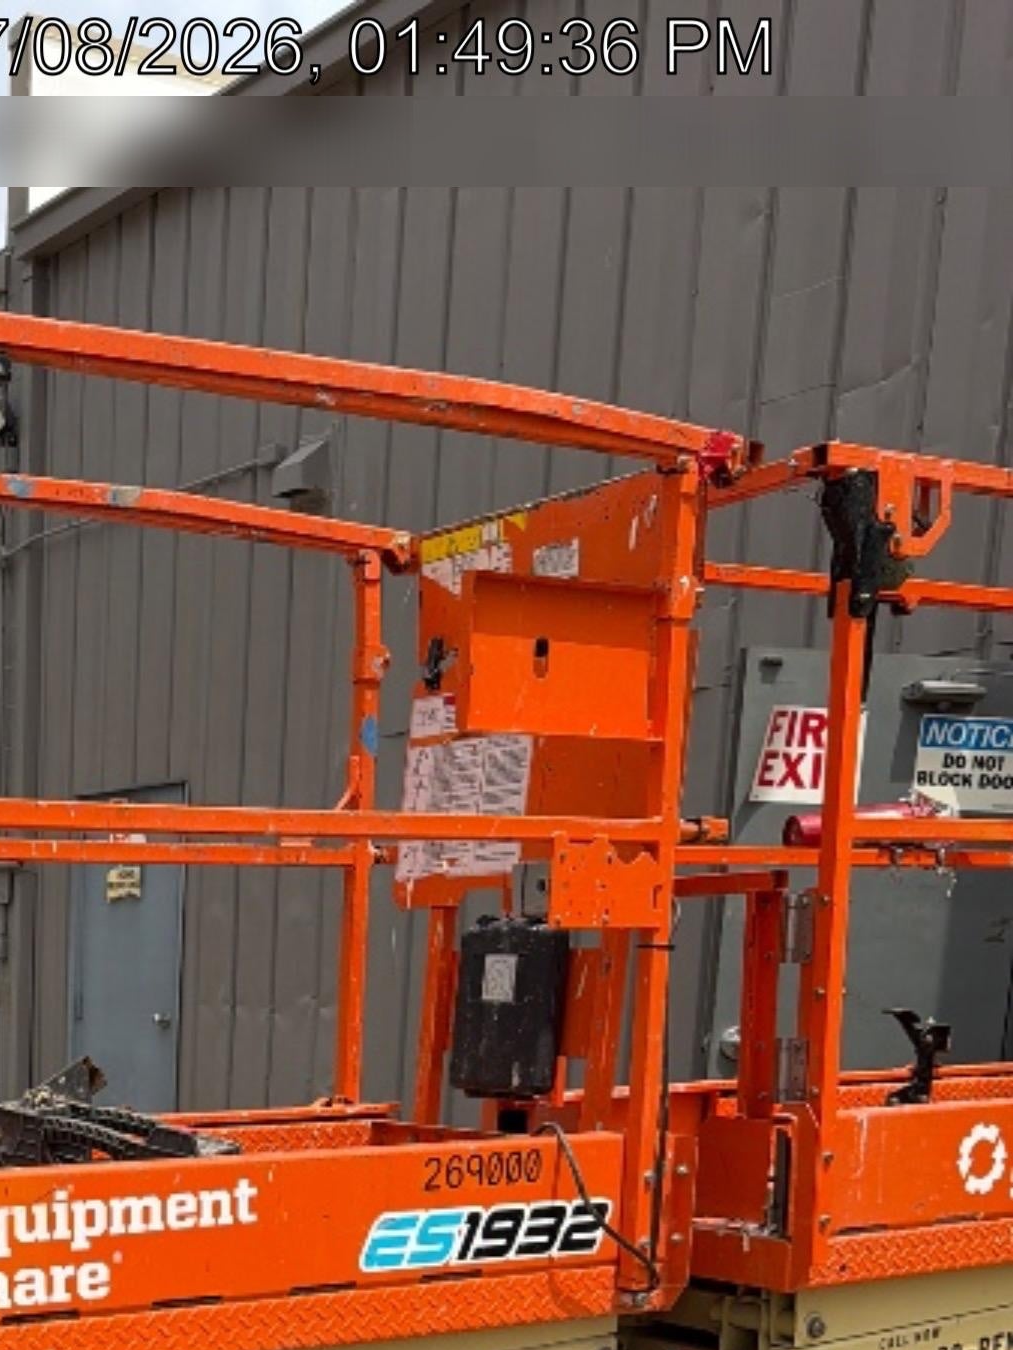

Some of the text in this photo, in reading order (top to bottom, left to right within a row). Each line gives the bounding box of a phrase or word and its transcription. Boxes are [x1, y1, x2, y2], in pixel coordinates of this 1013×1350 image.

[768, 711, 828, 747] FIR
[926, 720, 1013, 748] NOTIC
[757, 751, 822, 789] EXI
[917, 770, 972, 788] BLOCK
[942, 753, 1005, 771] DO NOT
[424, 1149, 542, 1191] 269000
[360, 1198, 611, 1271] ES1932
